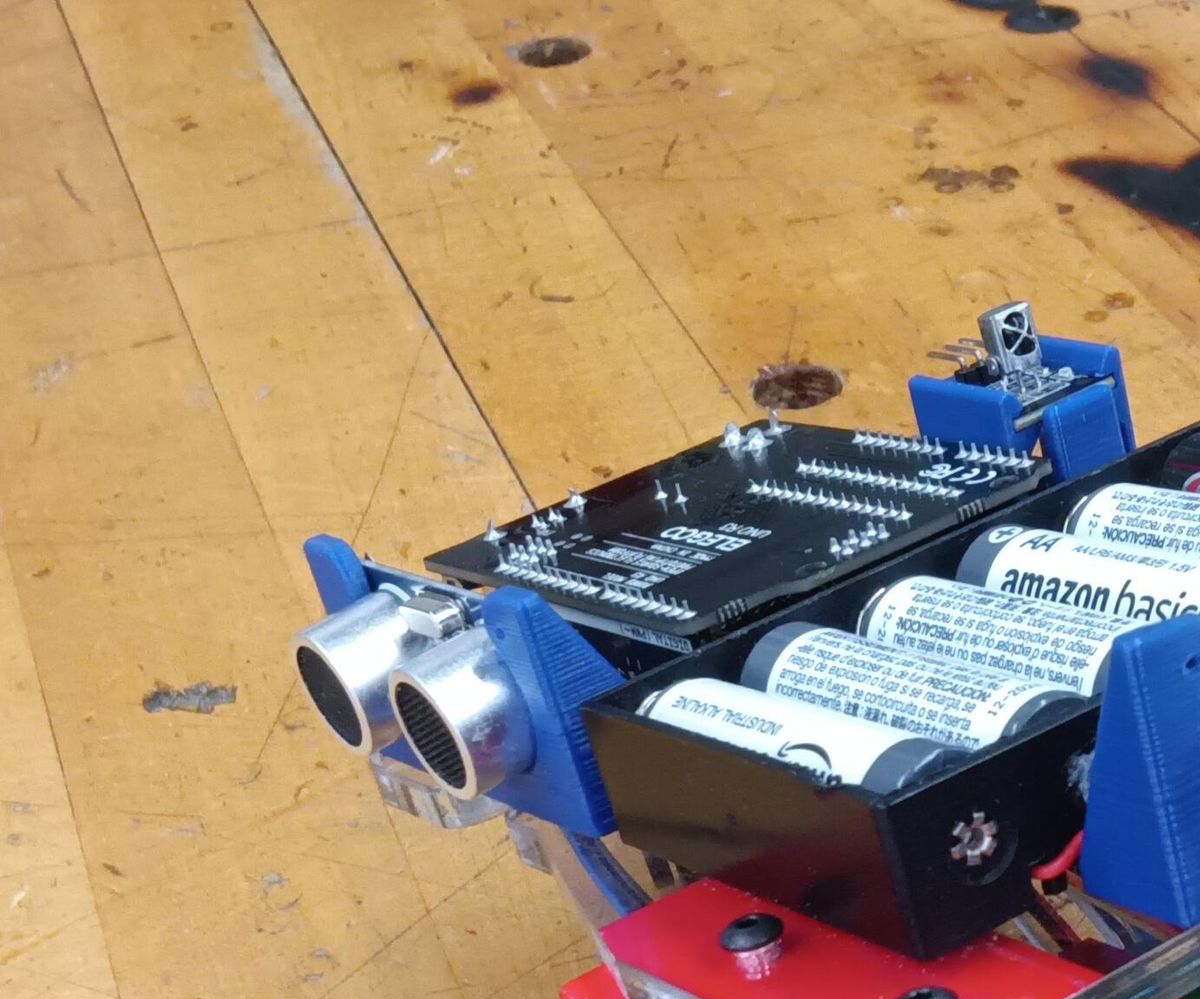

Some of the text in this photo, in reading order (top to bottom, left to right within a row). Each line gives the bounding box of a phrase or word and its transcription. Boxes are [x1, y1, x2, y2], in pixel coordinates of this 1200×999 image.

[718, 522, 772, 538] UNO R3
[661, 526, 750, 551] ELEGOO
[1020, 528, 1061, 552] AA
[1181, 540, 1194, 553] de
[1002, 570, 1108, 610] amazon
[975, 620, 996, 636] fuga
[969, 634, 982, 646] de
[982, 636, 995, 648] ou
[1050, 637, 1065, 651] de
[1065, 639, 1097, 656] riesgo
[957, 648, 969, 660] ou
[970, 651, 988, 665] pas
[1040, 647, 1067, 667] risque
[987, 655, 1023, 675] chargez
[787, 654, 814, 670] riesgo
[814, 660, 828, 672] de
[877, 677, 899, 693] fuga
[908, 687, 923, 698] se
[961, 701, 976, 713] se
[671, 696, 782, 735] INDUSTRIAL ALKALINE
